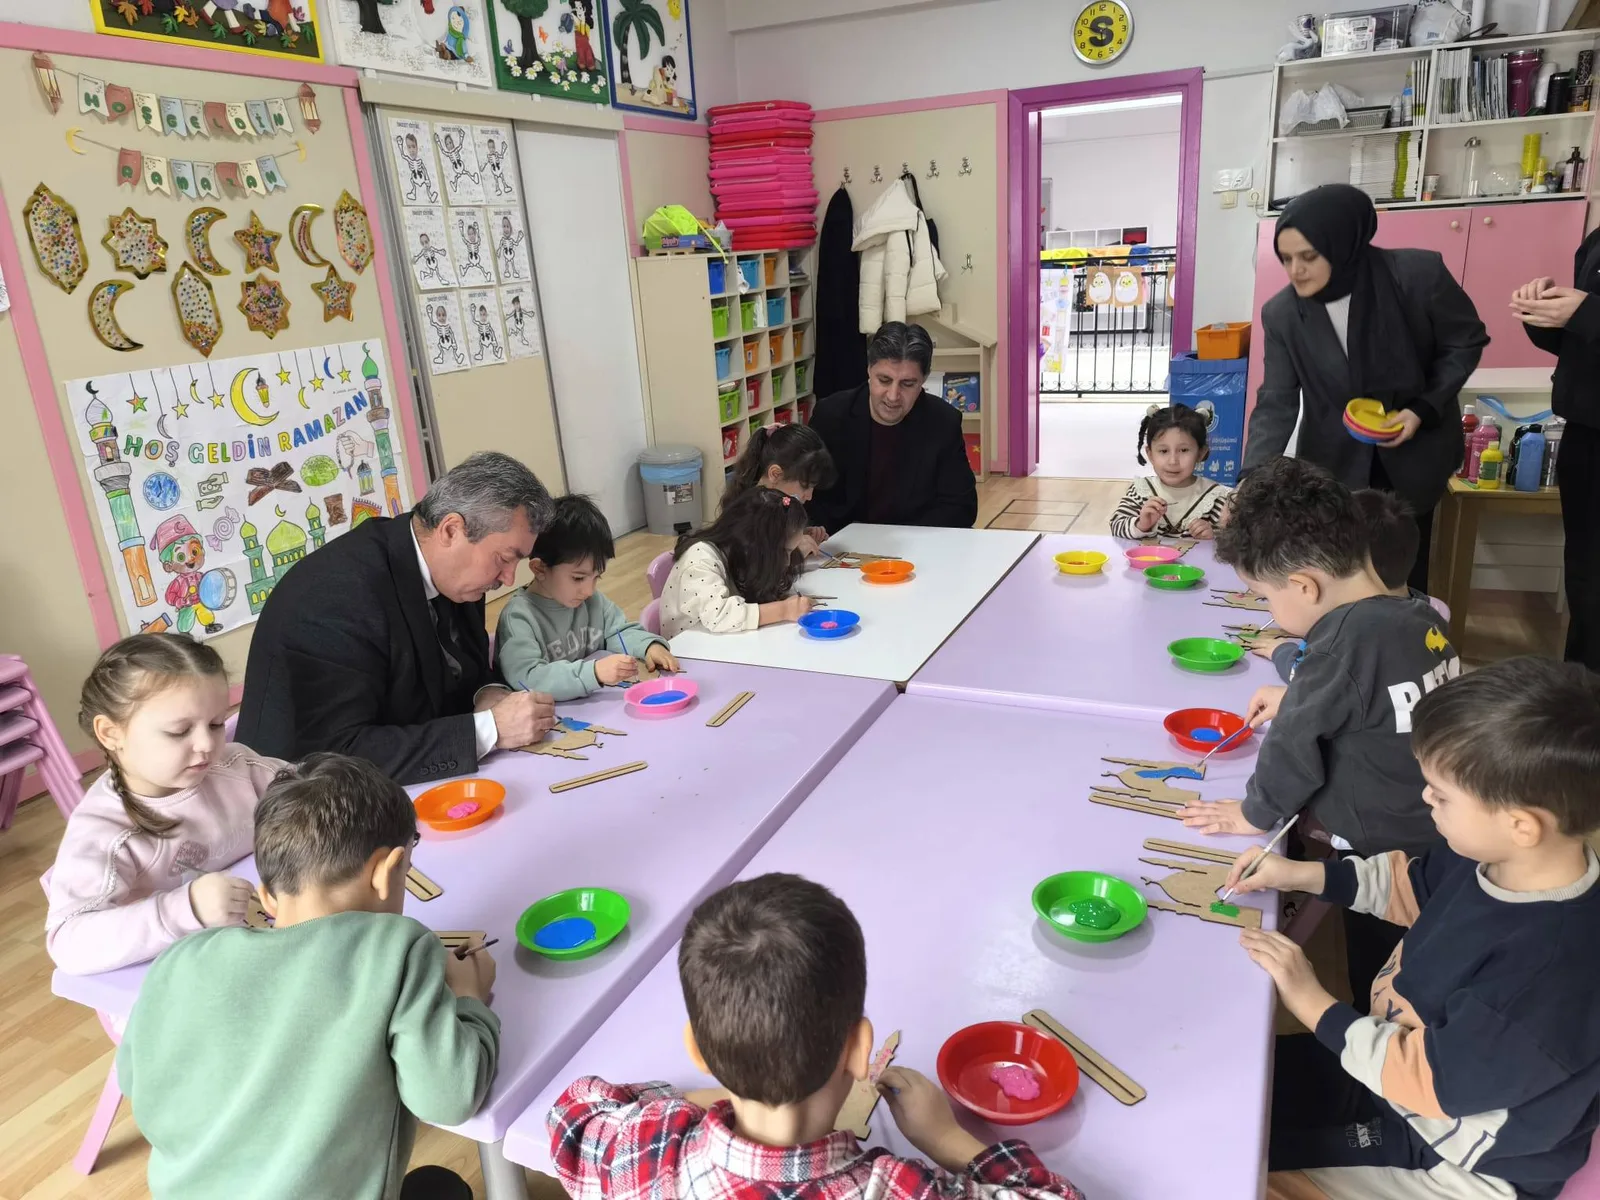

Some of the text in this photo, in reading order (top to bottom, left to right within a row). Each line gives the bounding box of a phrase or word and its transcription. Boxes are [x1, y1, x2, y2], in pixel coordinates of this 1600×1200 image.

[1089, 16, 1113, 47] S
[124, 391, 368, 467] HOŞ GELDİN RAMAZAN
